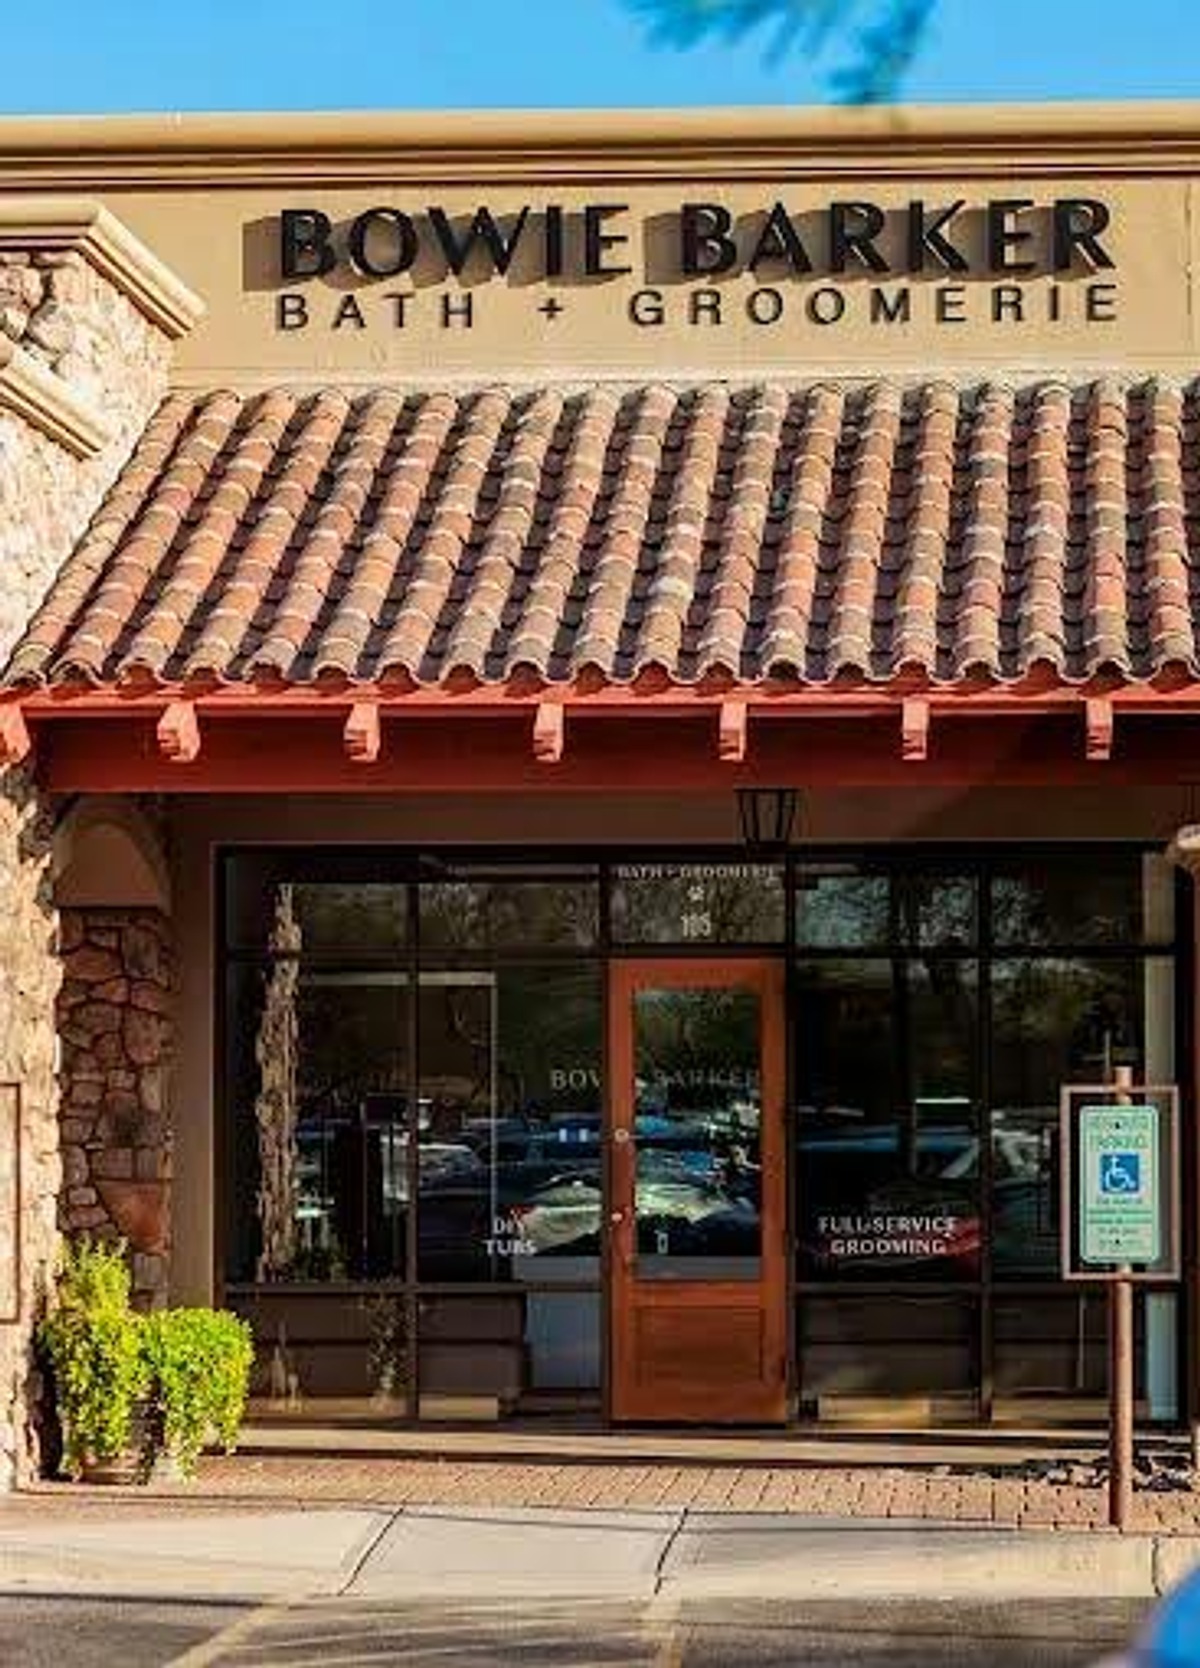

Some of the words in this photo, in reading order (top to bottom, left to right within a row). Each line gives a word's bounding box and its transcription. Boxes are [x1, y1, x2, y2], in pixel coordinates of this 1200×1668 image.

[279, 204, 633, 278] BOWIE
[680, 200, 1117, 275] BARKER
[276, 293, 474, 331] BATH
[537, 298, 564, 321] +
[628, 285, 1119, 325] GROOMERIE
[830, 1239, 948, 1255] GROOMING
